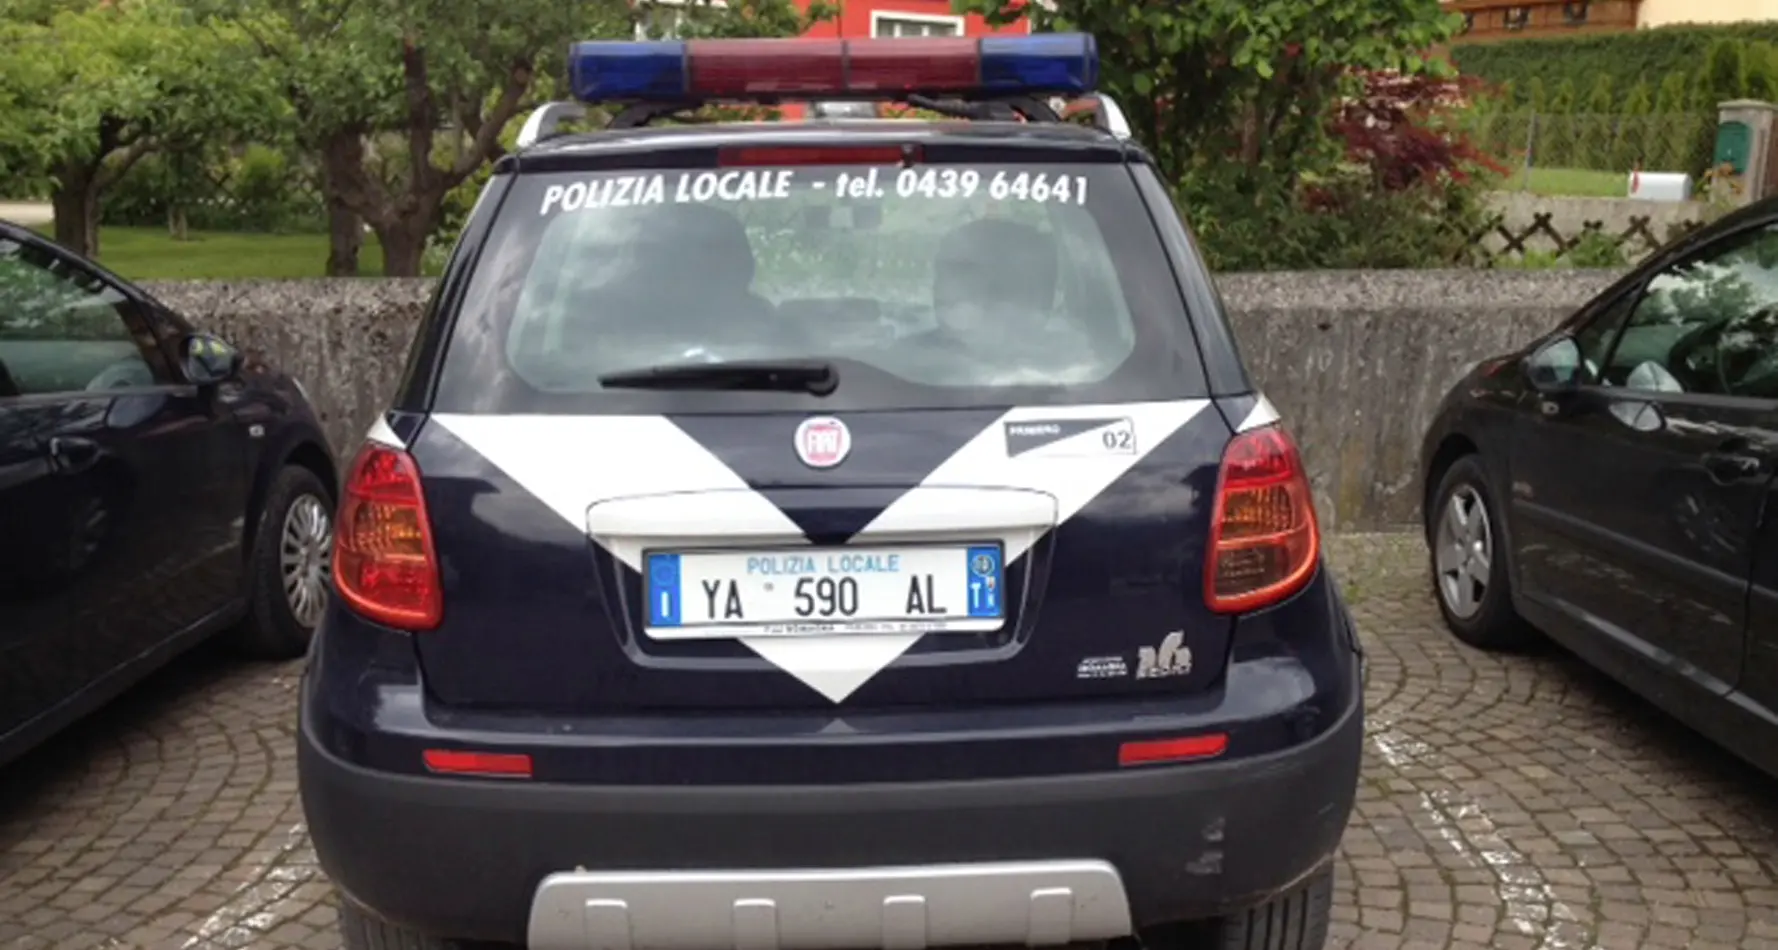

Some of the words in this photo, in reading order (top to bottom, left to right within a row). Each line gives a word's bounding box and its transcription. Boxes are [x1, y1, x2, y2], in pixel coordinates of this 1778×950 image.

[540, 174, 664, 214] POLIZIA
[674, 170, 794, 203] LOCALE
[836, 168, 884, 198] tel.
[896, 168, 980, 199] 0439
[990, 170, 1088, 206] 64641
[1102, 430, 1132, 450] 02
[747, 555, 816, 575] POLIZIA
[828, 554, 900, 574] LOCALE
[702, 578, 745, 620] YA
[794, 576, 860, 617] 590
[905, 573, 948, 615] AL
